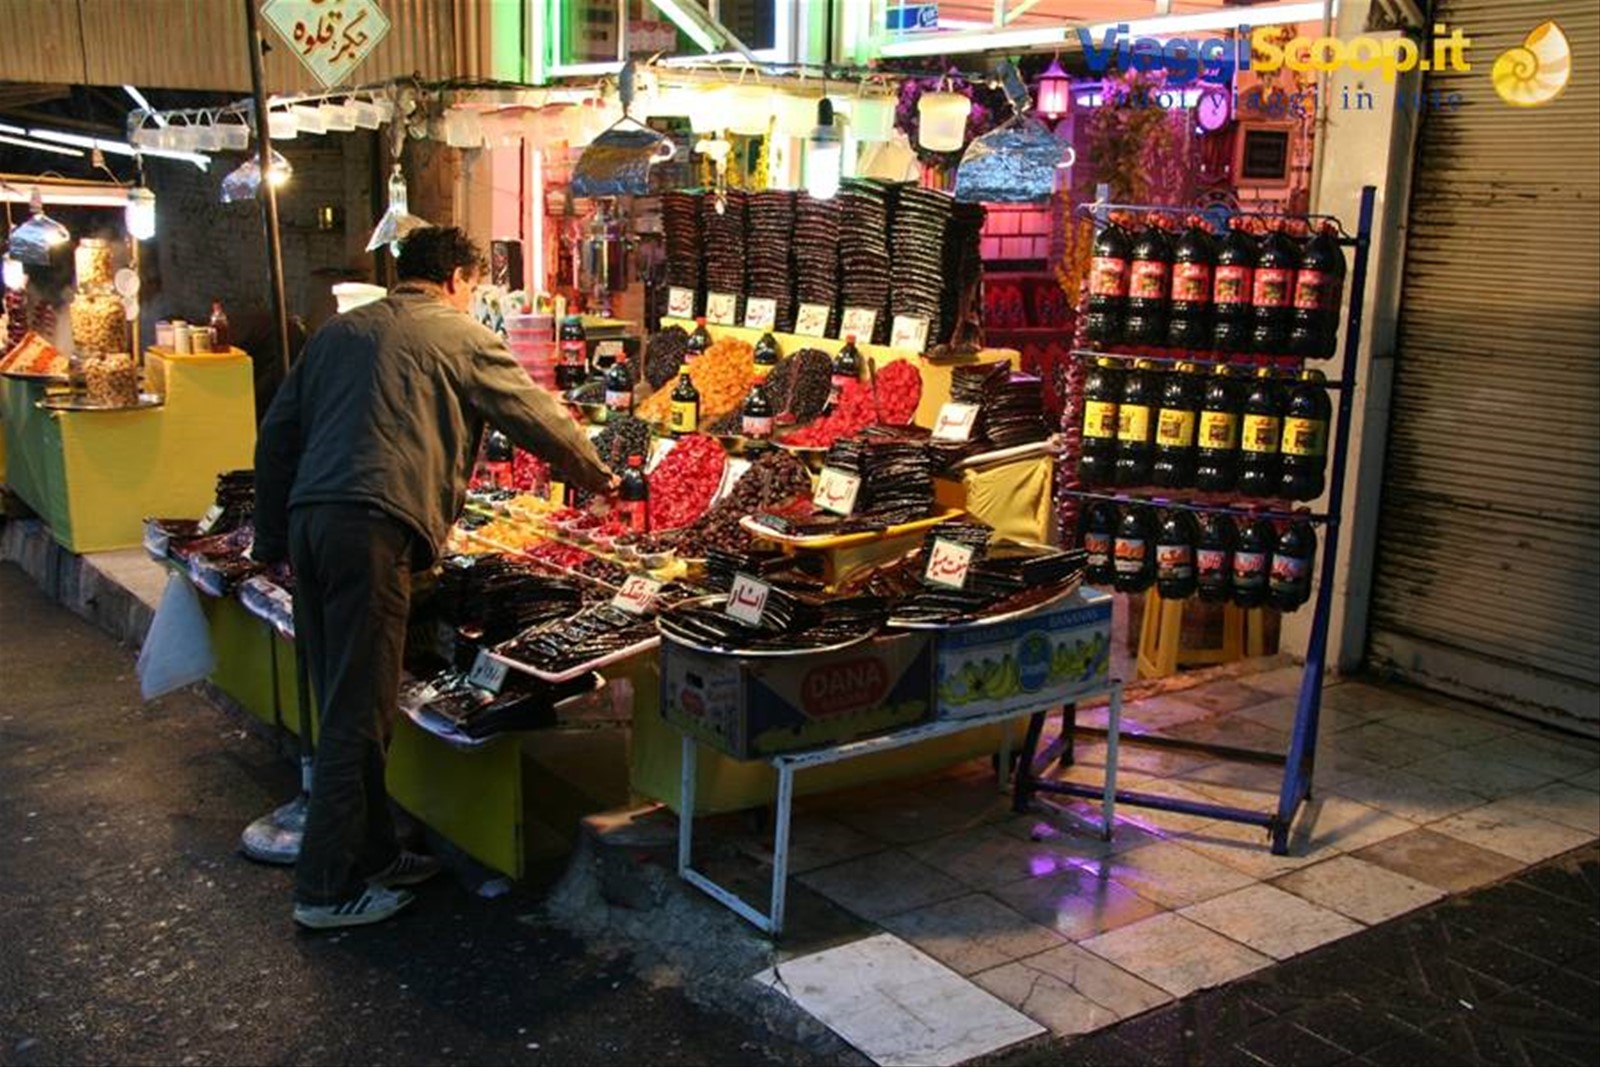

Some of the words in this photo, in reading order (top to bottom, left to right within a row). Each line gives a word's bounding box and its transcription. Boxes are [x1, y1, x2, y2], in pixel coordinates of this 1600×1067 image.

[293, 10, 343, 55] قلوه
[729, 584, 766, 612] انار
[808, 661, 882, 699] DANA
